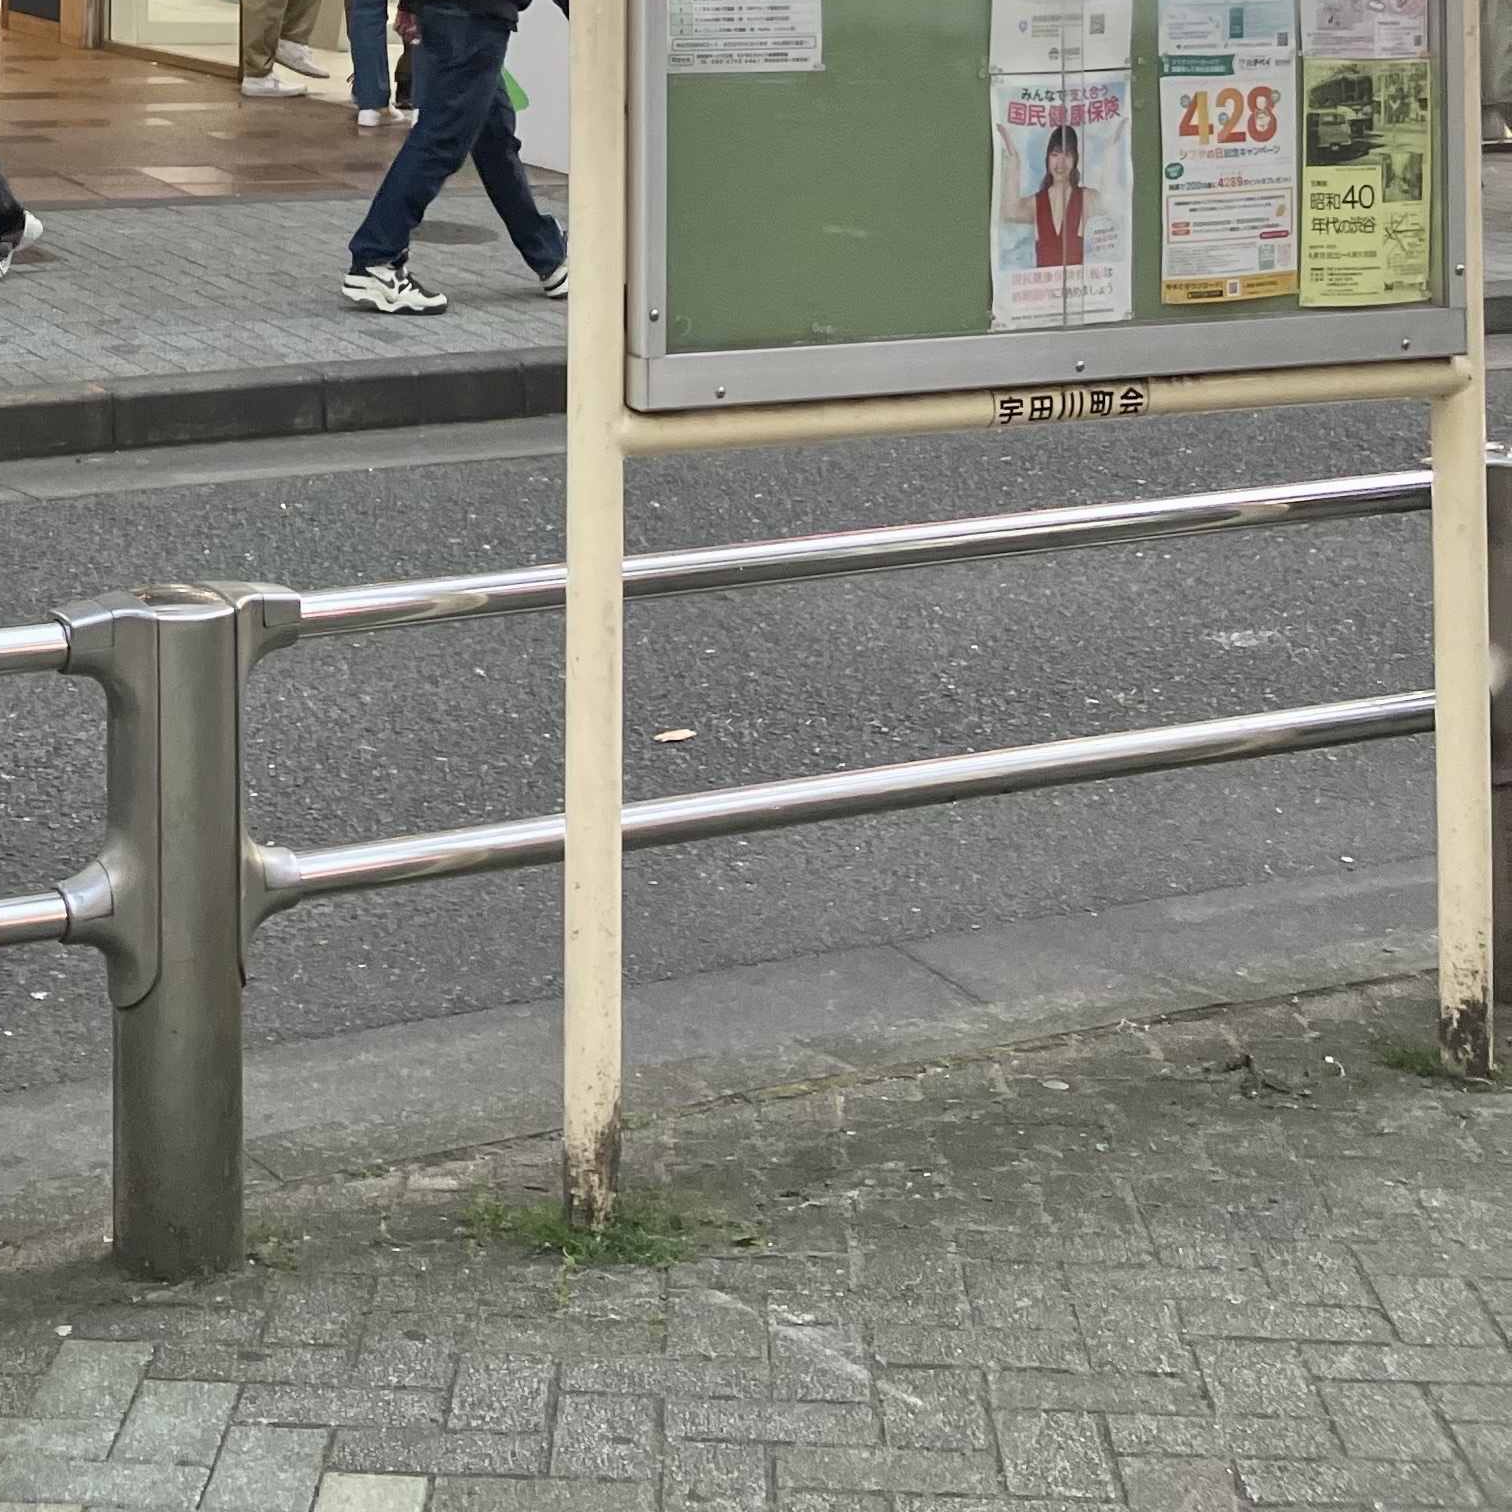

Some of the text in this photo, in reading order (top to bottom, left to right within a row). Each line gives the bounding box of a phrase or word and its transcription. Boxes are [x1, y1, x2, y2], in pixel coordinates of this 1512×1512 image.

[1008, 95, 1121, 127] 国民健康保険
[1179, 86, 1278, 145] 428
[1311, 216, 1377, 235] 年代の渋谷
[999, 386, 1145, 424] 宇田川町会
